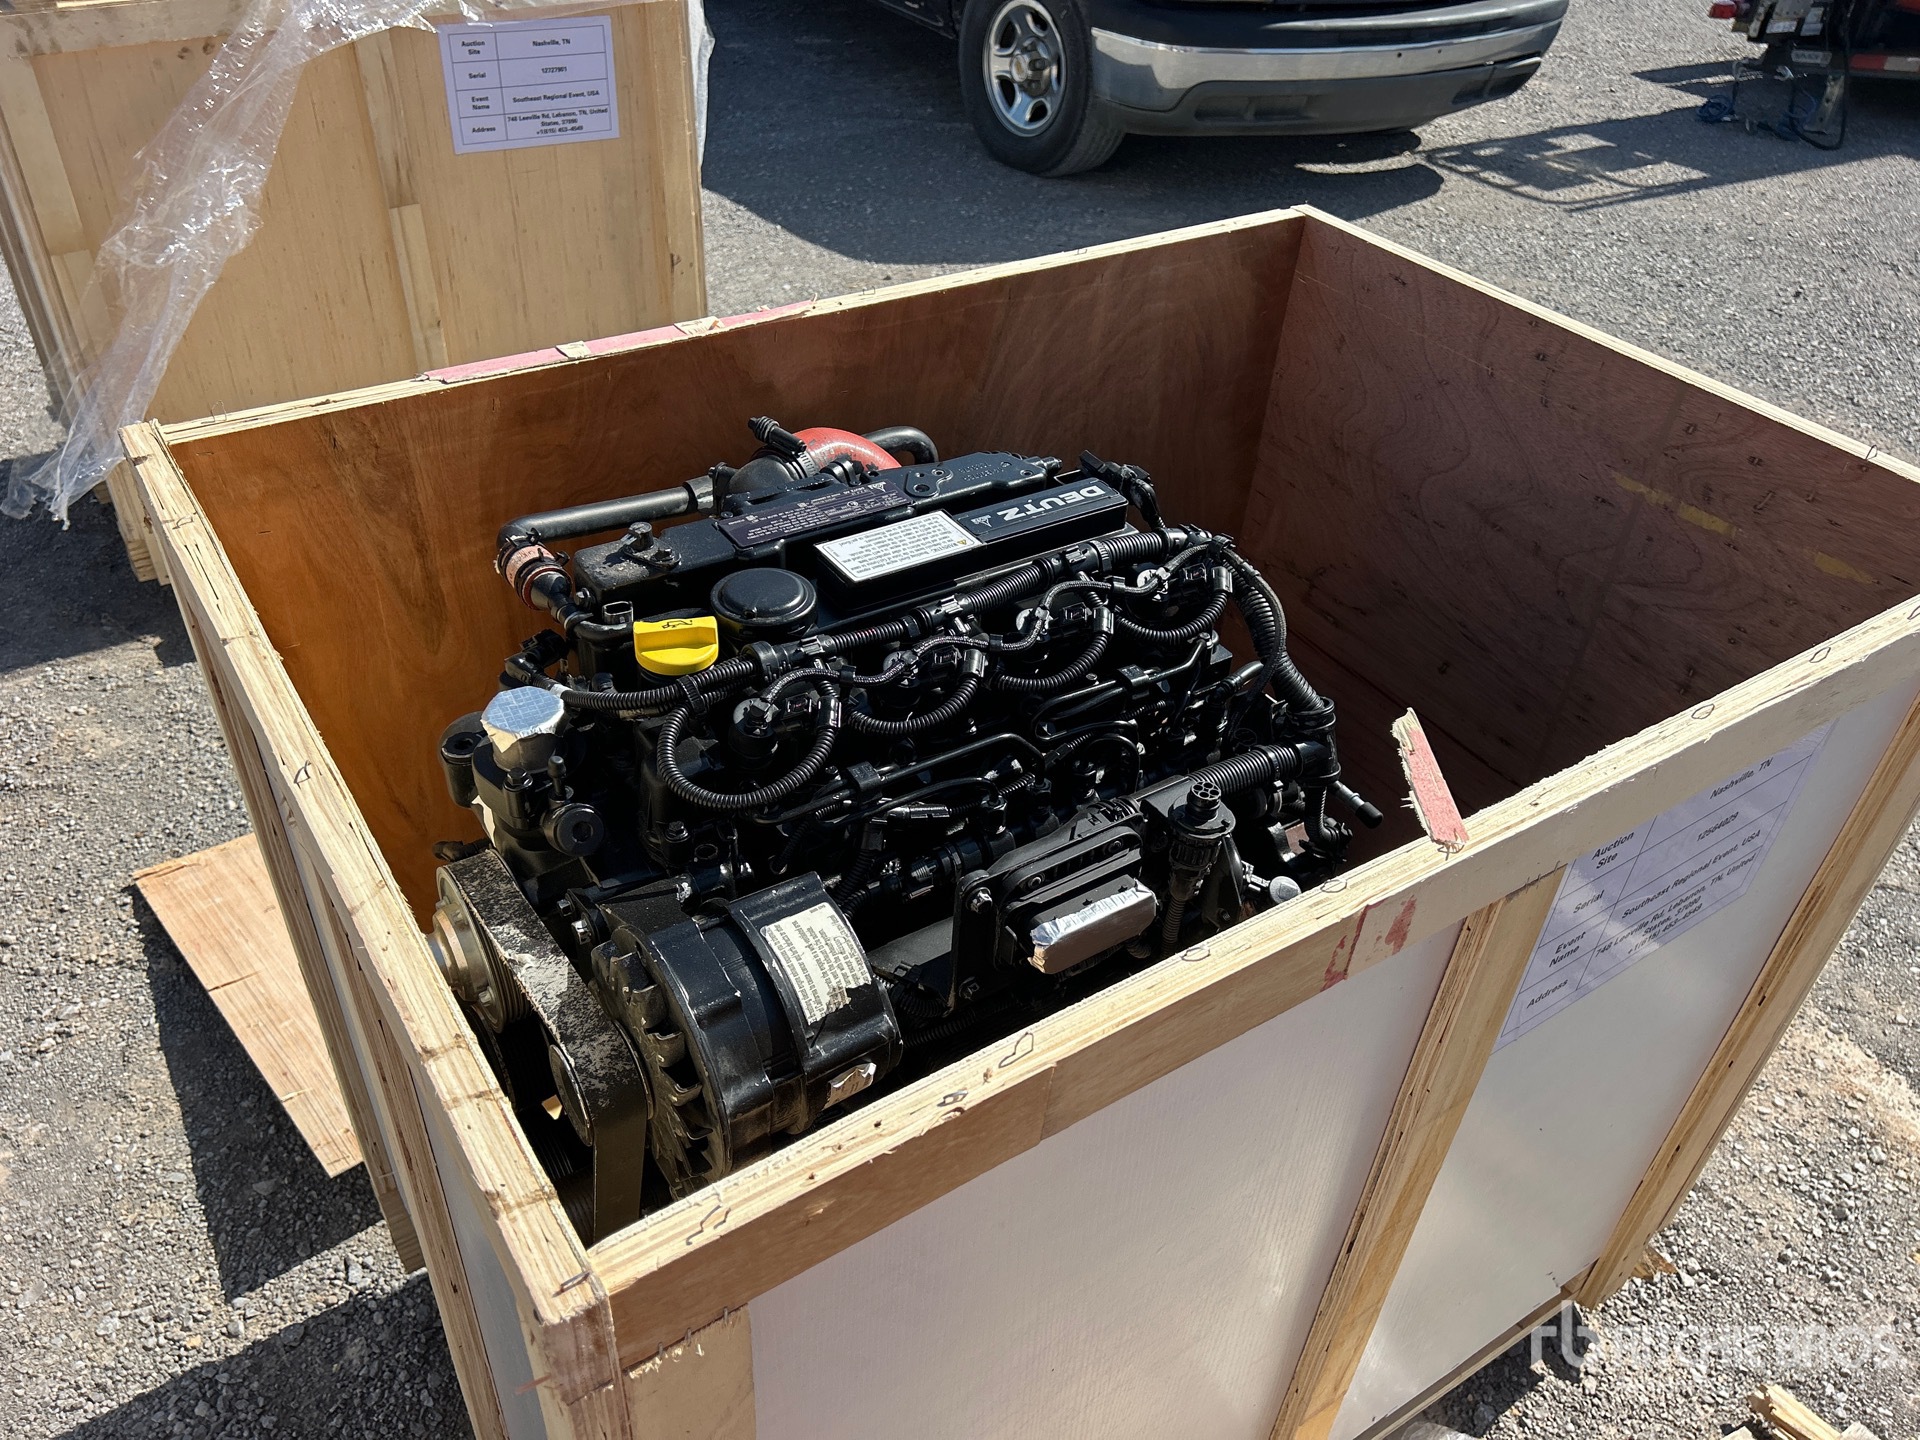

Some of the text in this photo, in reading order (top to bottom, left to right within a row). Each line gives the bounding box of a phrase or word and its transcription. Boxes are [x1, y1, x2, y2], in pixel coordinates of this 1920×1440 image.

[997, 485, 1106, 521] DEUTZ
[1710, 757, 1773, 799] Nashville, TN
[1592, 832, 1634, 860] Auction
[1596, 853, 1617, 869] Site
[1727, 853, 1756, 875] United
[1622, 885, 1670, 918] Southeast
[1671, 859, 1712, 889] Regional
[1742, 830, 1760, 846] USA
[1573, 890, 1605, 913] Serial
[1555, 932, 1586, 954] Event
[1549, 946, 1579, 967] Name
[1527, 980, 1568, 1008] Address
